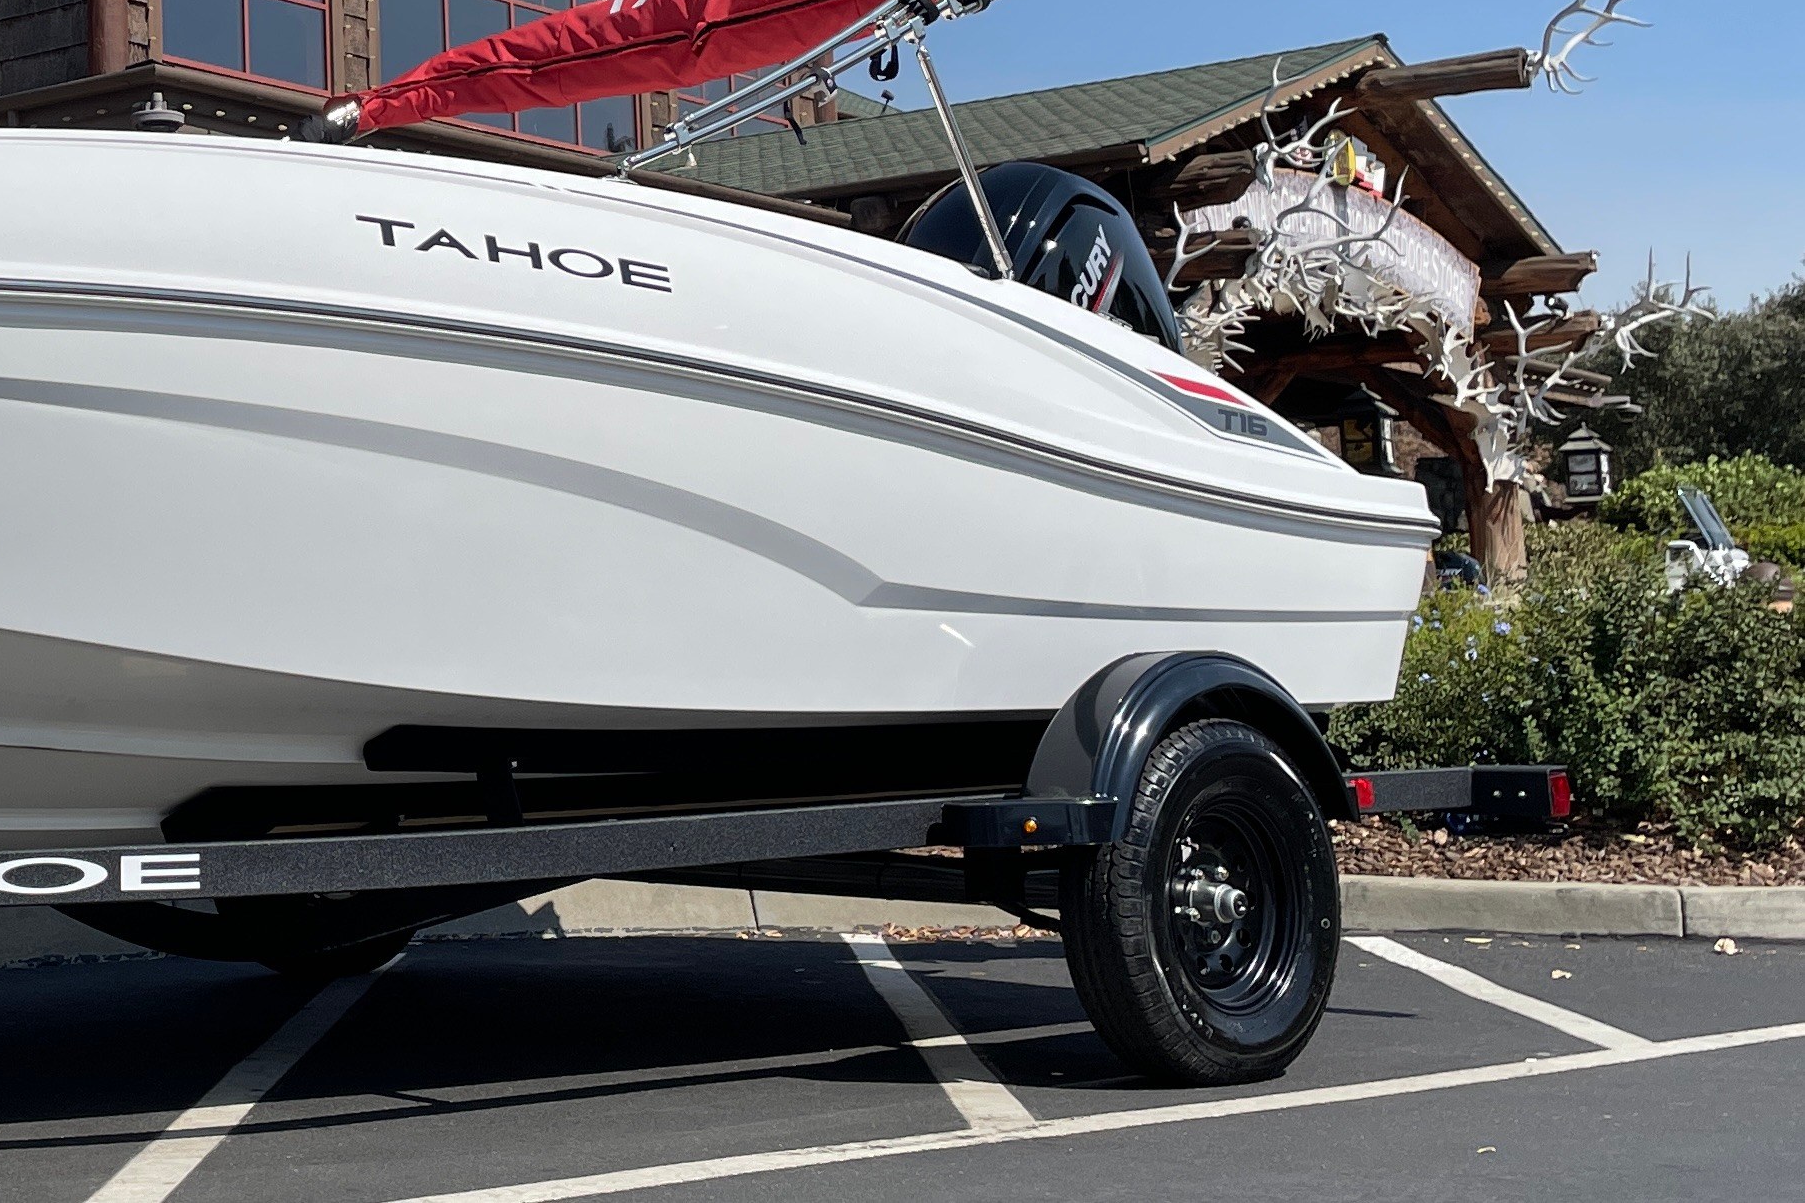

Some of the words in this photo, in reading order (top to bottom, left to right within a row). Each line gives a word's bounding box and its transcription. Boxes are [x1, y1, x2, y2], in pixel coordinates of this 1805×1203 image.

[354, 213, 673, 294] TAHOE
[1431, 245, 1468, 311] STORE
[1217, 408, 1268, 437] T16
